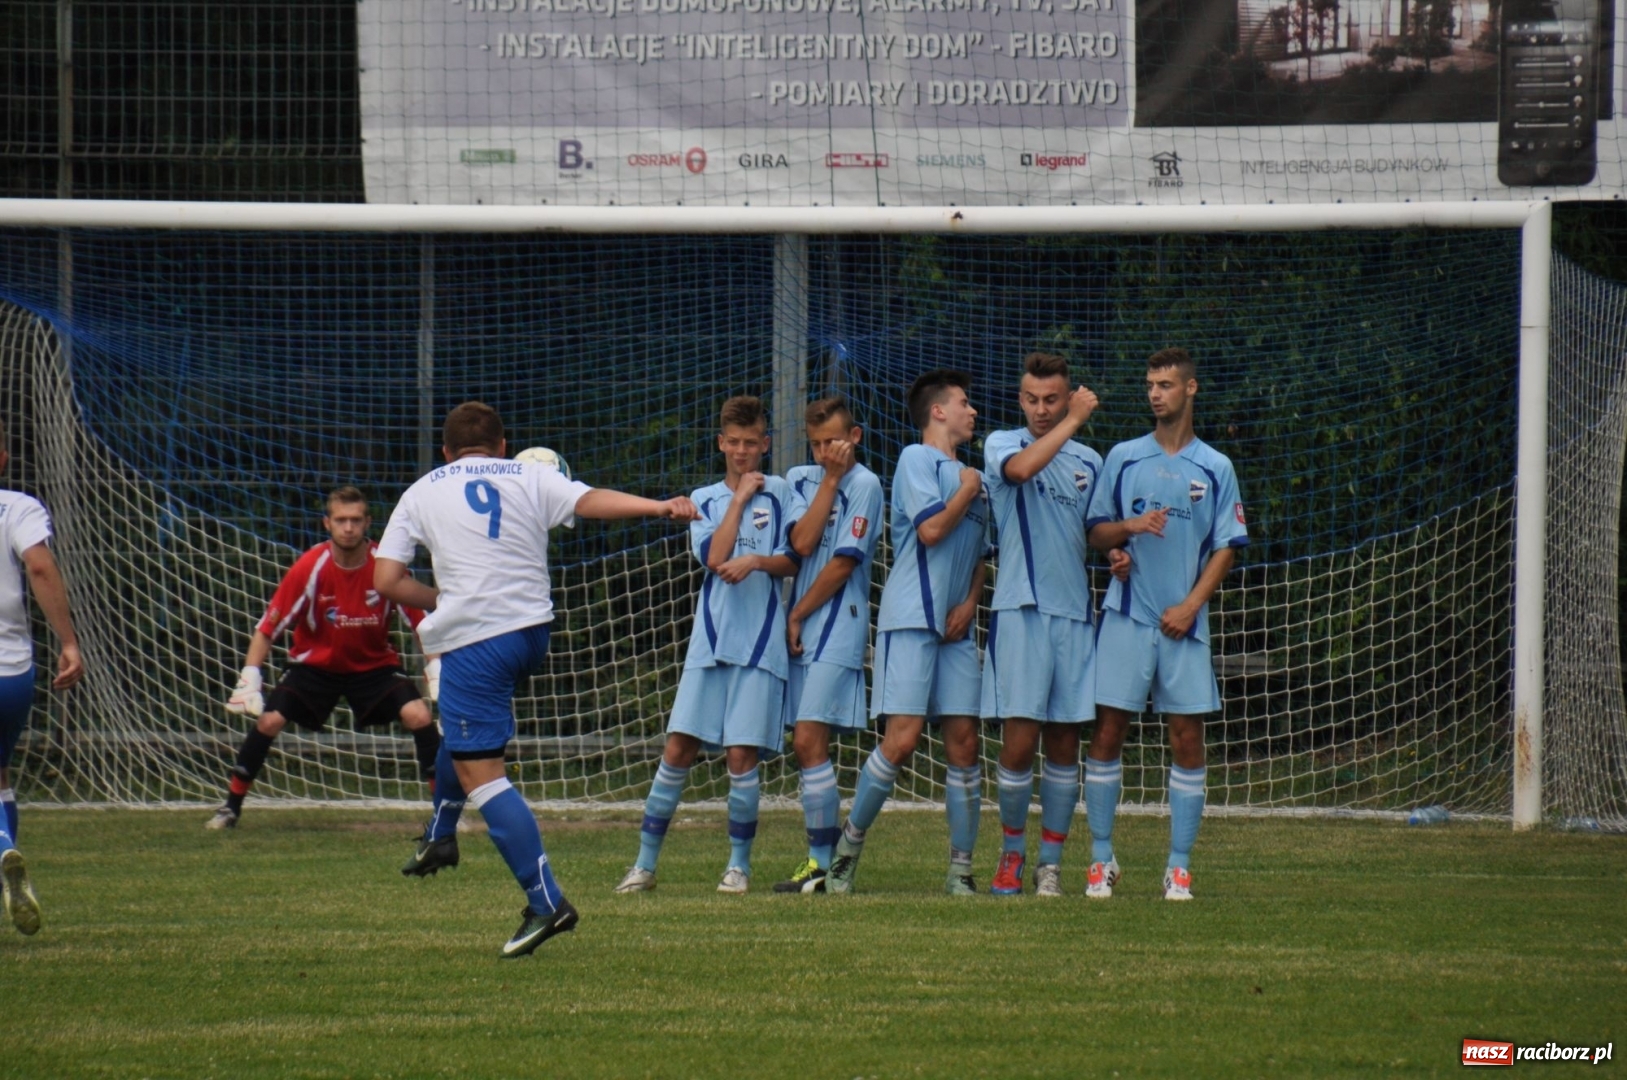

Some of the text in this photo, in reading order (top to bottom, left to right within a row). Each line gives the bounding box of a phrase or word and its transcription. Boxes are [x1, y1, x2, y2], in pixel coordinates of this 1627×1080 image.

[498, 33, 665, 66] INSTALACJE
[1009, 31, 1119, 58] FIBARO
[769, 80, 905, 106] POMIARY
[912, 80, 921, 105] I
[927, 79, 1119, 106] DORADZTWO
[627, 153, 681, 167] OSRAM
[738, 153, 789, 168] GIRA
[915, 153, 987, 167] SIEMENS
[1035, 153, 1087, 170] legrand
[1240, 158, 1351, 175] INTELIGENCJA
[465, 462, 523, 476] MARKOWICE
[464, 478, 502, 539] 9
